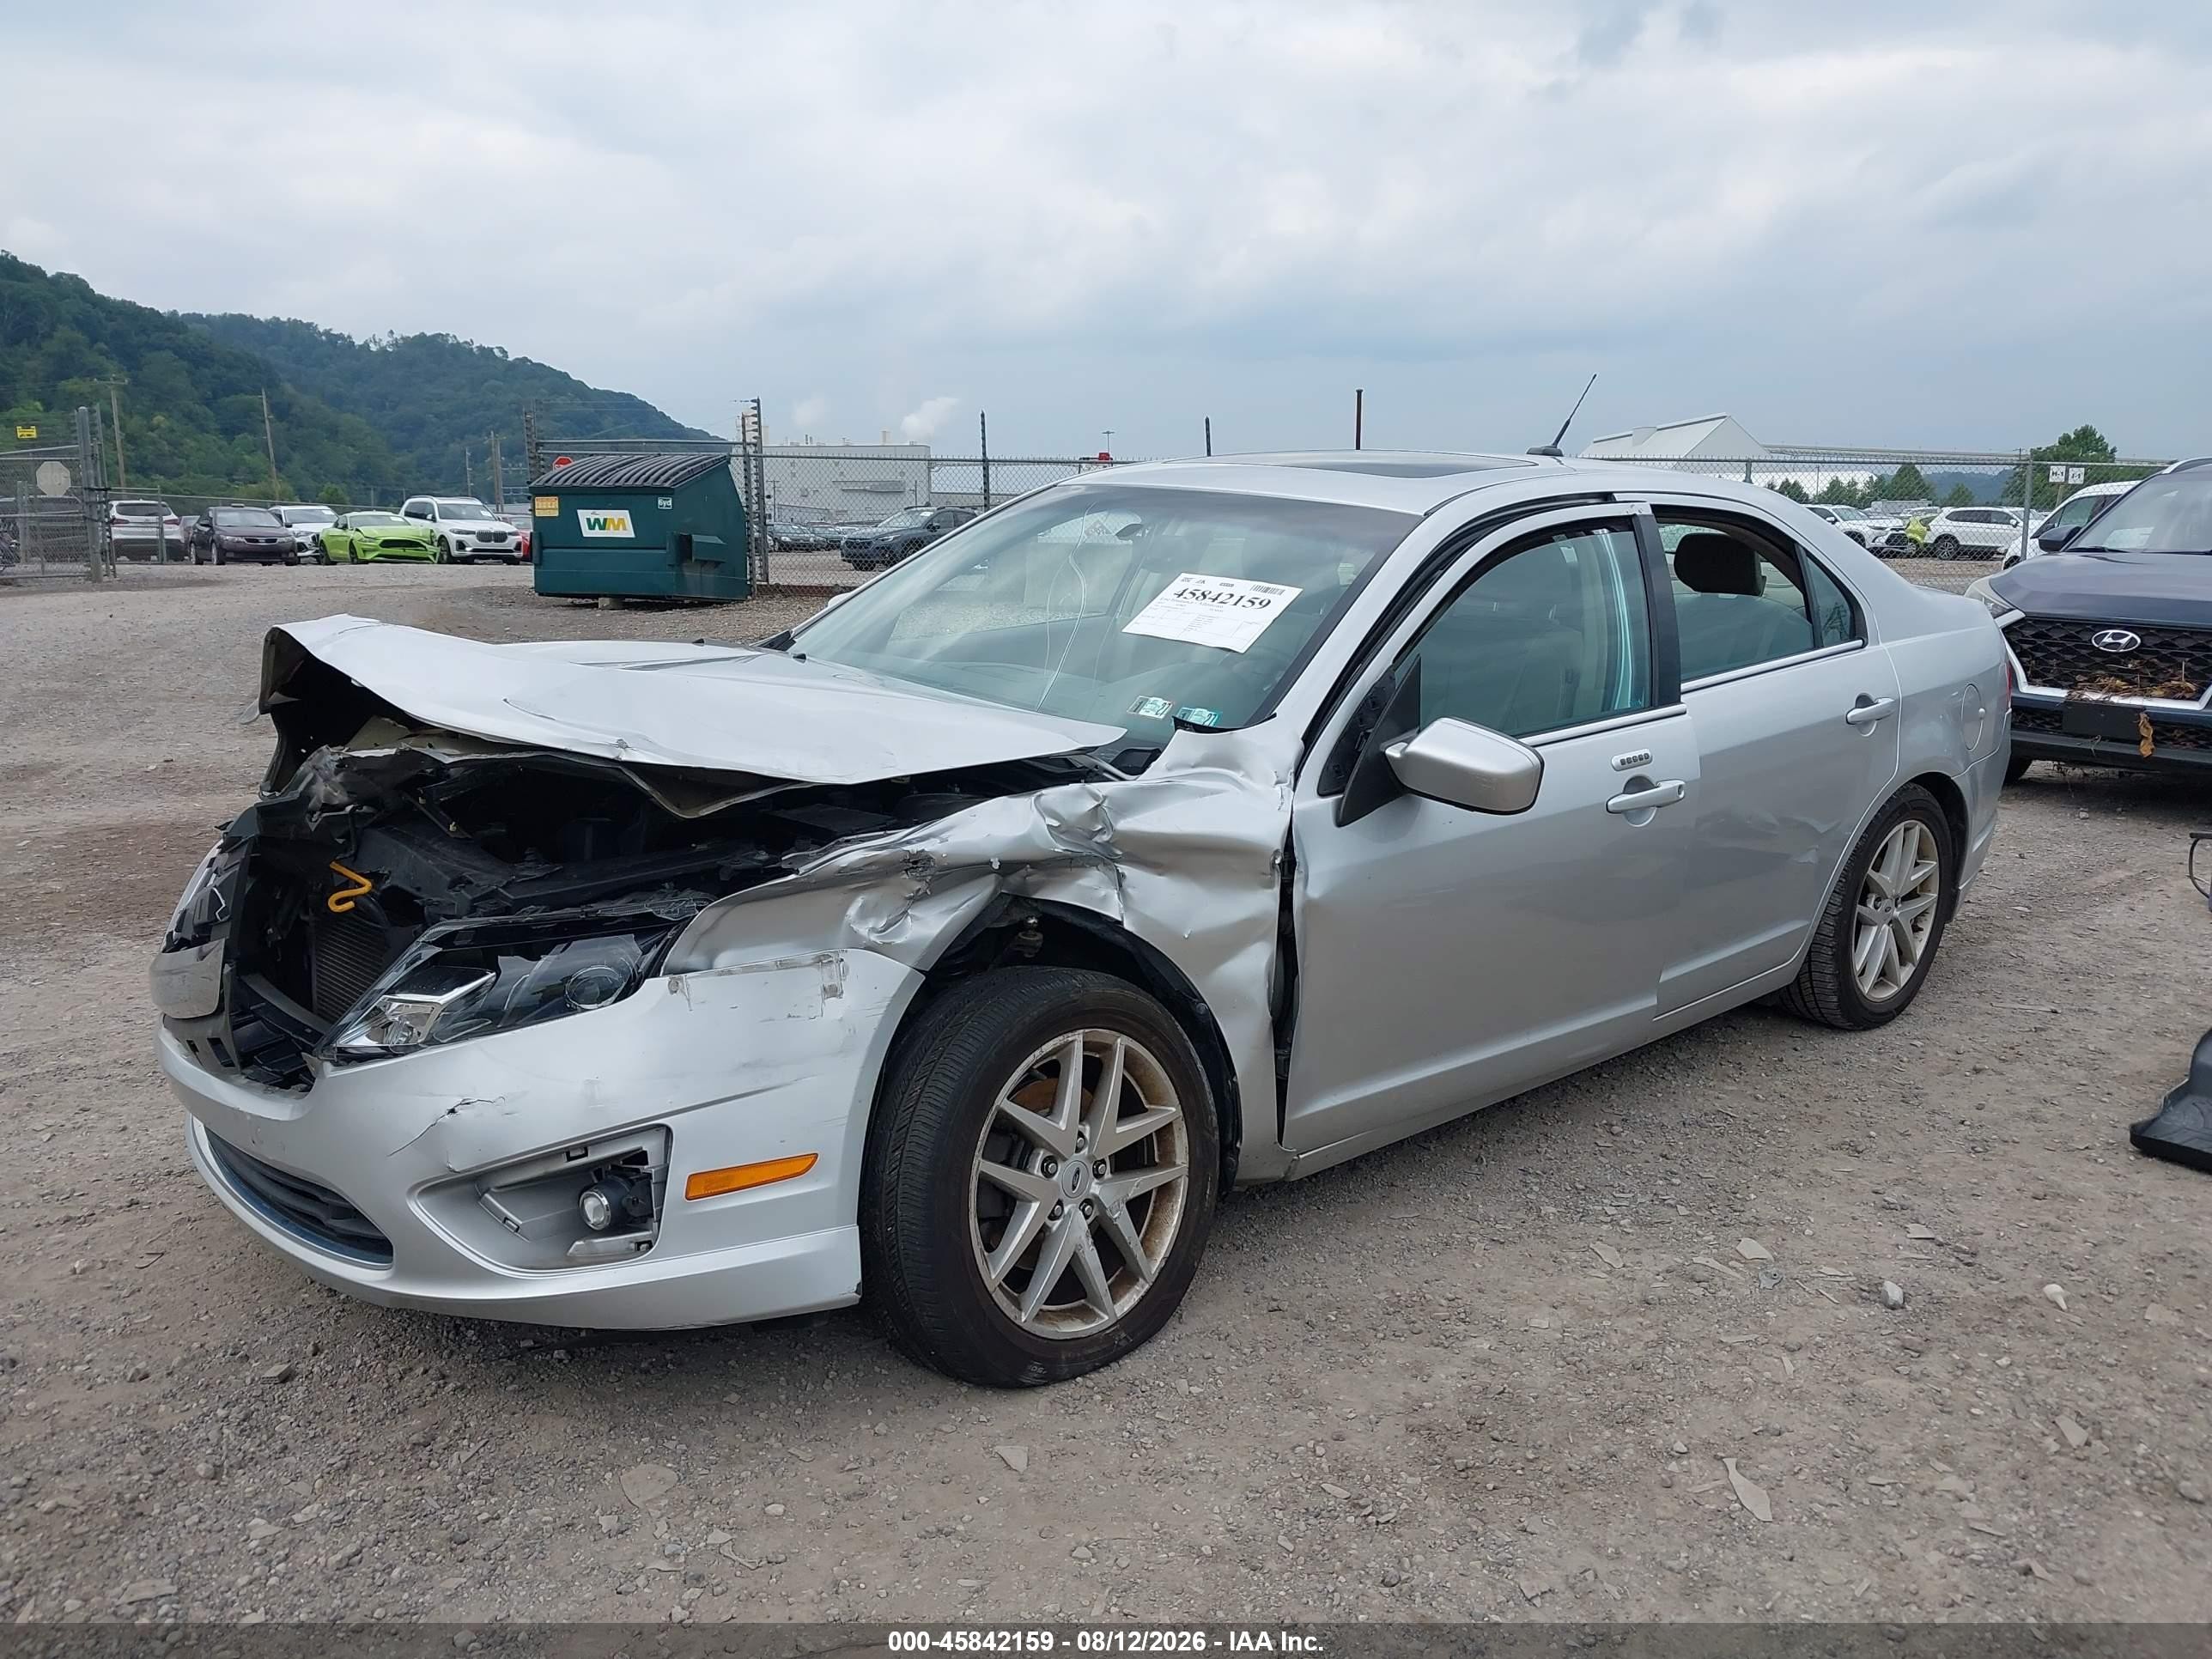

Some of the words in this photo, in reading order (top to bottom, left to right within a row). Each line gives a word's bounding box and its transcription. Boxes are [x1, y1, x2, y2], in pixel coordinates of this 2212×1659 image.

[659, 498, 672, 507] 6yd
[586, 517, 627, 531] WM
[1173, 586, 1272, 610] 45842159
